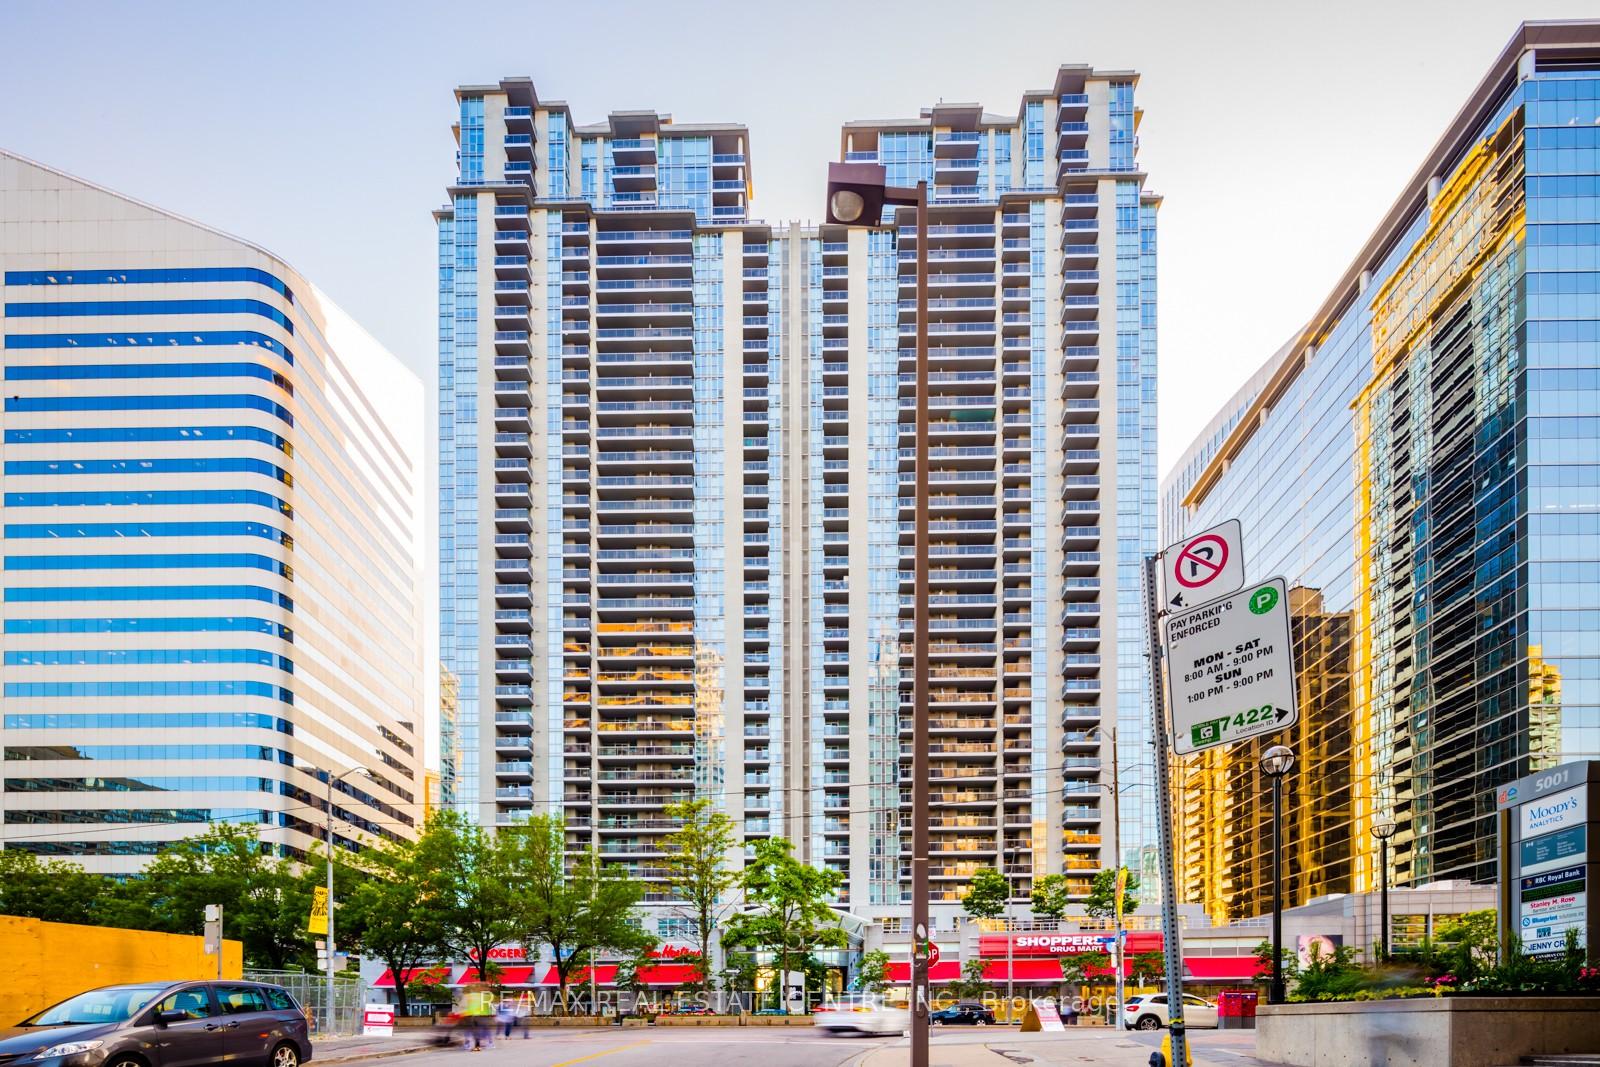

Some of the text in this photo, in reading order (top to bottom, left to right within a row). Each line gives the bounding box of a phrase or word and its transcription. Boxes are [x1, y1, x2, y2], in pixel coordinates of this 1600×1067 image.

[1170, 601, 1233, 631] PAY PARKING
[1171, 618, 1221, 642] ENFORCED
[1193, 651, 1224, 668] MON
[1235, 638, 1260, 654] SAT
[1184, 669, 1203, 682] 8:00
[1207, 662, 1223, 675] AM
[1233, 652, 1253, 666] 9:00
[1256, 645, 1273, 658] PM
[1215, 667, 1242, 683] SUN
[1187, 691, 1205, 703] 1:00
[1207, 685, 1223, 697] PM
[1233, 676, 1253, 688] 9:00
[1256, 669, 1273, 681] PM
[1219, 704, 1273, 731] 7422
[1235, 722, 1265, 735] Location
[1535, 769, 1569, 792] 5001
[1529, 815, 1564, 829] ANALYTICS
[1535, 869, 1581, 884] RBC Royal Bank
[1530, 900, 1550, 909] Stanley
[1049, 945, 1076, 953] DRUG
[1529, 941, 1553, 951] JENNY
